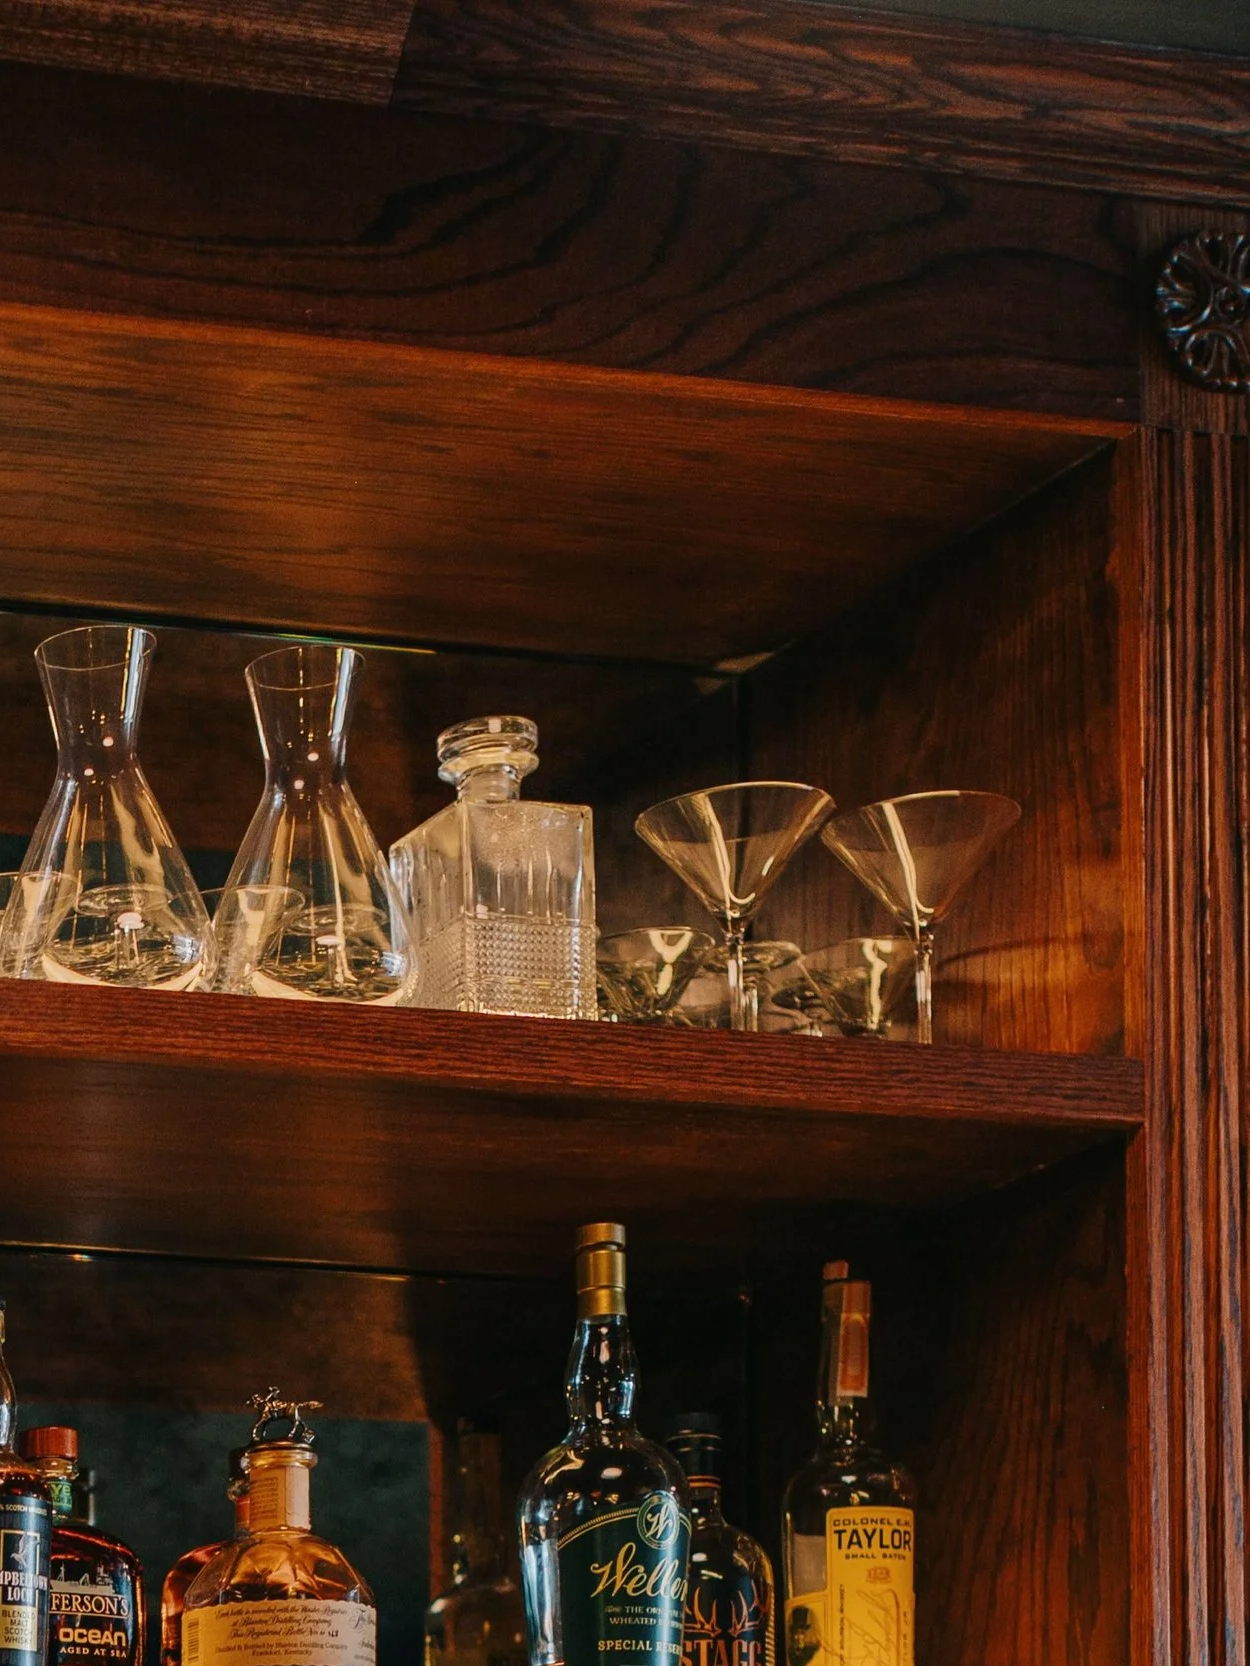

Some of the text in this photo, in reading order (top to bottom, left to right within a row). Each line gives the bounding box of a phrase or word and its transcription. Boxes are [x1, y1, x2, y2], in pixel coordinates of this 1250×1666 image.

[833, 1517, 893, 1527] COLONEL
[833, 1528, 912, 1552] TAYLOR
[7, 1586, 36, 1602] LOC
[51, 1592, 129, 1616] FERSON'S
[1, 1609, 36, 1620] BLENDED
[625, 1606, 644, 1614] THE
[10, 1618, 29, 1627] MALT
[610, 1617, 657, 1626] WHEATED
[59, 1627, 127, 1647] OCEAN
[598, 1640, 653, 1651] SPECIAL
